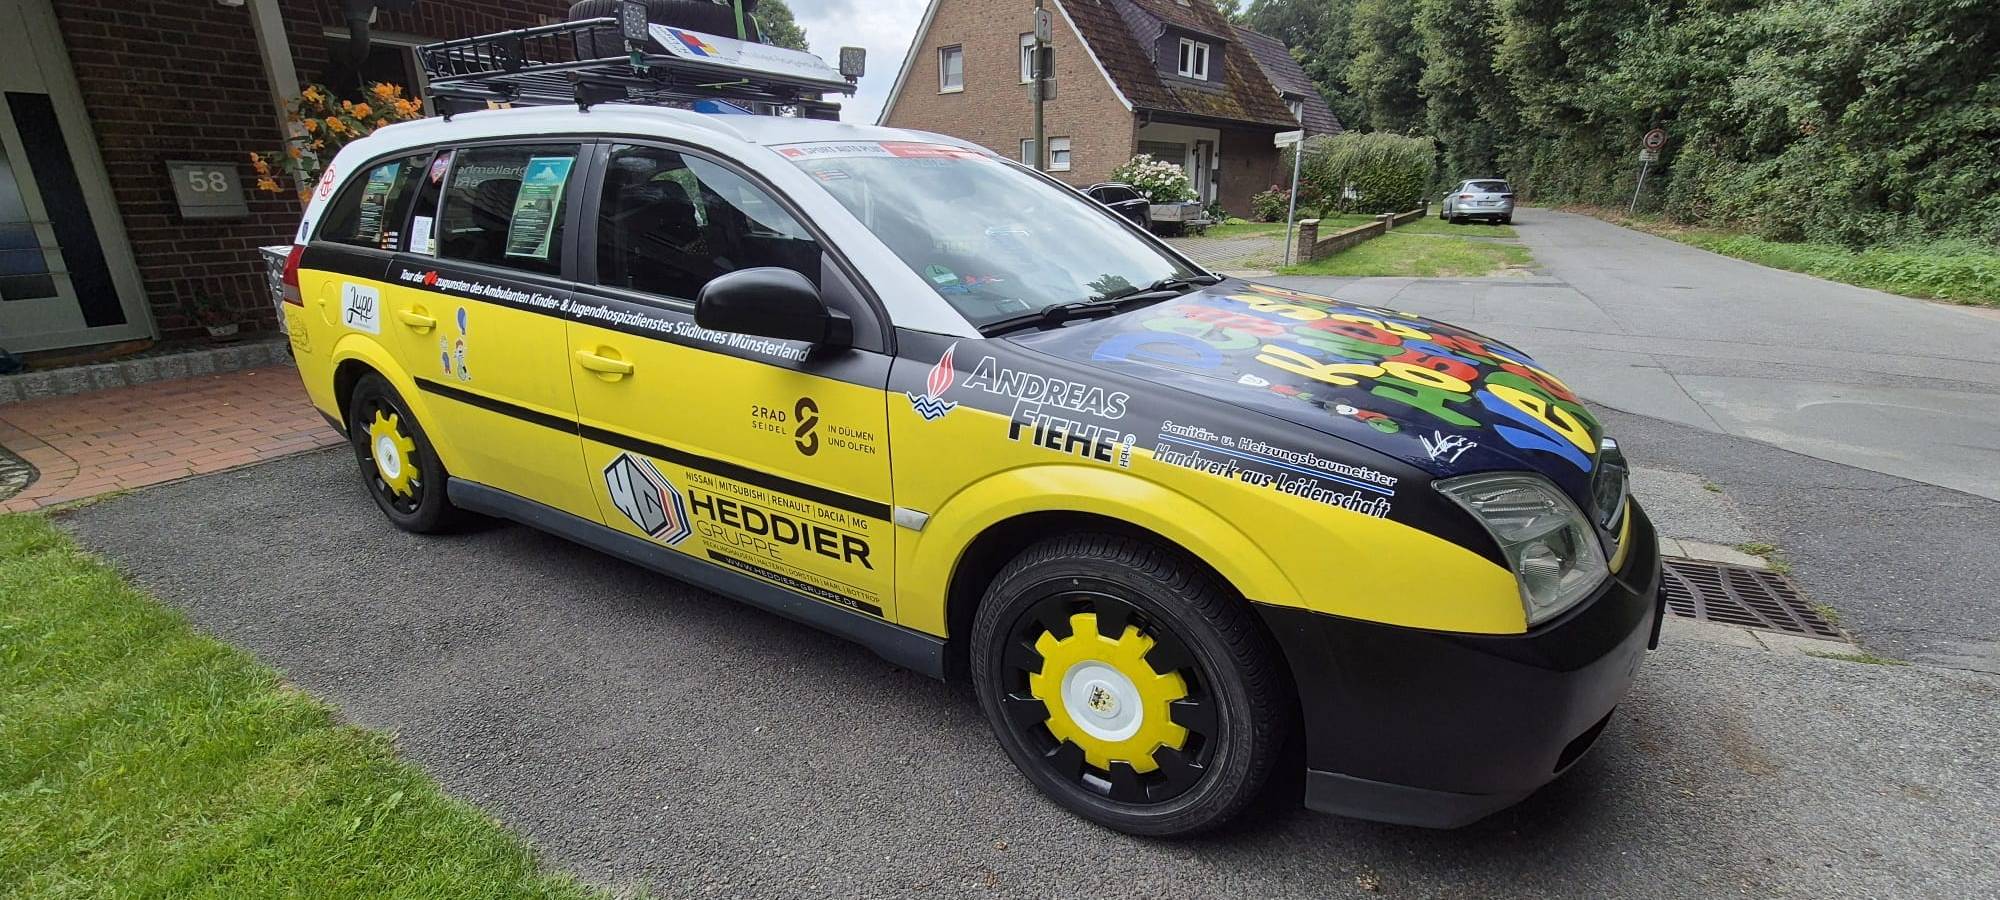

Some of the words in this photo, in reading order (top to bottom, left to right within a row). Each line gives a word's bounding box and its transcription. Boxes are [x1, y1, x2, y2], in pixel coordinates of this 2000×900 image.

[189, 171, 228, 192] 58
[400, 269, 412, 281] Tour
[413, 270, 425, 282] der
[435, 277, 470, 292] zugunsten
[470, 282, 484, 294] des
[483, 284, 529, 304] Ambulanten
[530, 293, 560, 309] Kinder-
[560, 298, 569, 312] &
[568, 300, 673, 334] Jugendhospizdienstes
[674, 321, 727, 345] Südliches
[727, 332, 812, 363] Münsterland
[752, 405, 786, 422] 2RAD
[962, 356, 1130, 420] ANDREAS
[752, 421, 787, 435] SEIDEL
[828, 424, 837, 433] IN
[839, 425, 874, 441] DÜLMEN
[828, 437, 846, 448] UND
[847, 441, 876, 455] OLFEN
[1008, 400, 1121, 464] FIEHE
[1119, 433, 1137, 469] GmbH
[1161, 420, 1219, 443] Sanitär-
[1221, 435, 1235, 447] u.
[1237, 437, 1398, 488] Heizungsbaumeister
[686, 471, 714, 487] NISSAN
[719, 481, 766, 502] MITSUBISHI
[771, 496, 811, 514] RENAULT
[817, 508, 845, 524] DACIA
[852, 517, 868, 530] MG
[1152, 442, 1240, 479] Handwerk
[1240, 466, 1273, 488] aus
[1274, 472, 1391, 519] Leidenschaft
[688, 490, 874, 570] HEDDIER
[696, 519, 783, 560] GRUPPE
